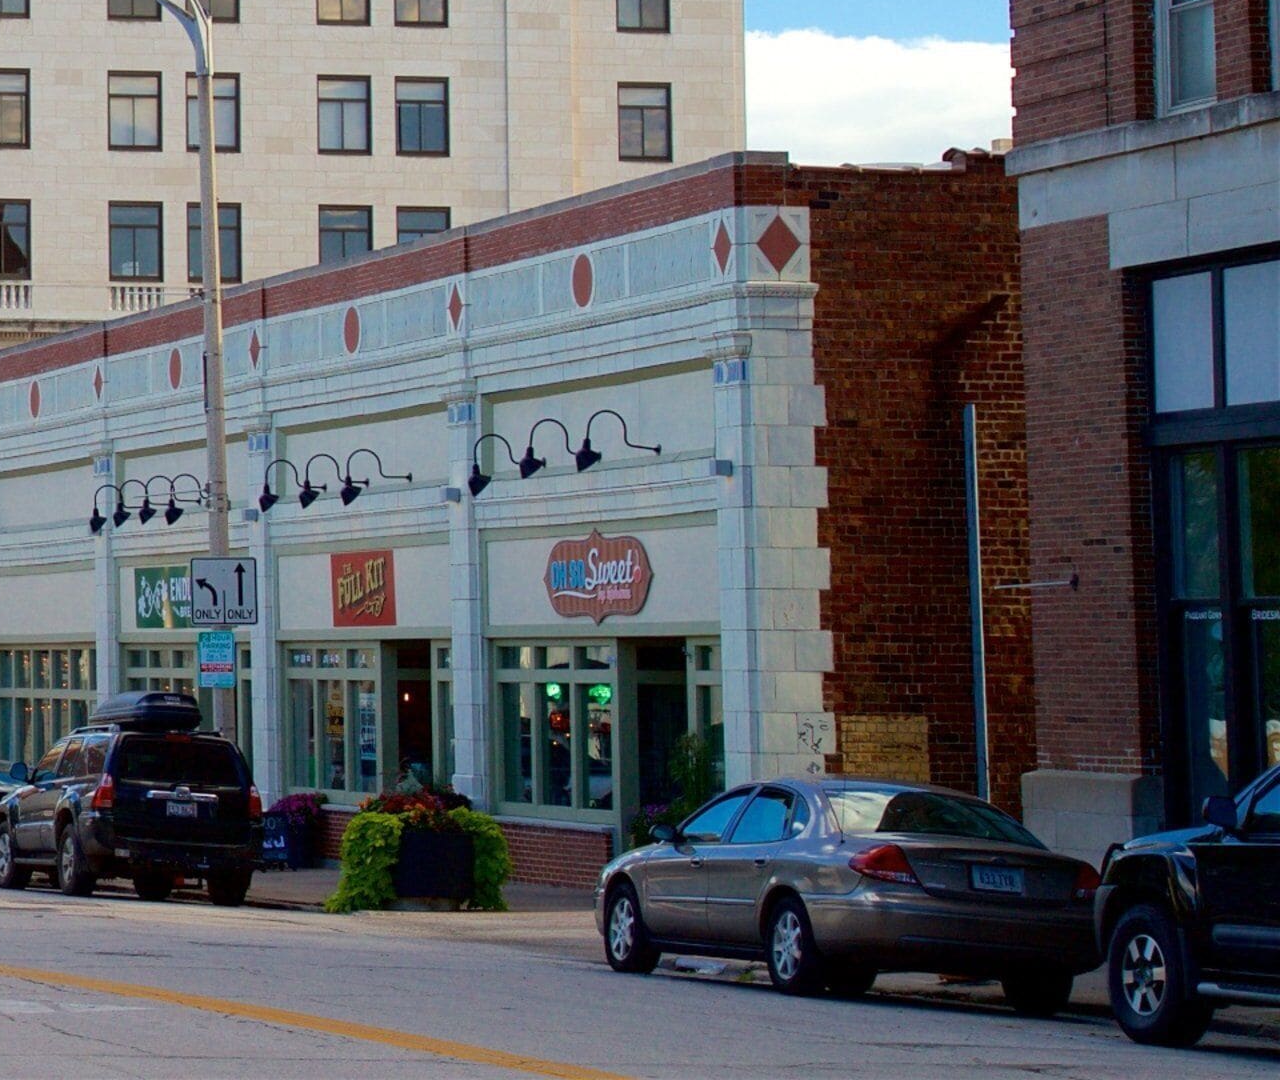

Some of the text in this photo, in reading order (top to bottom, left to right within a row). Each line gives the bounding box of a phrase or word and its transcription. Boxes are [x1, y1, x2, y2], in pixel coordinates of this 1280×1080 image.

[337, 557, 385, 611] FULL KIT
[551, 548, 634, 590] OH SO Sweet
[195, 608, 254, 620] ONLY ONLY
